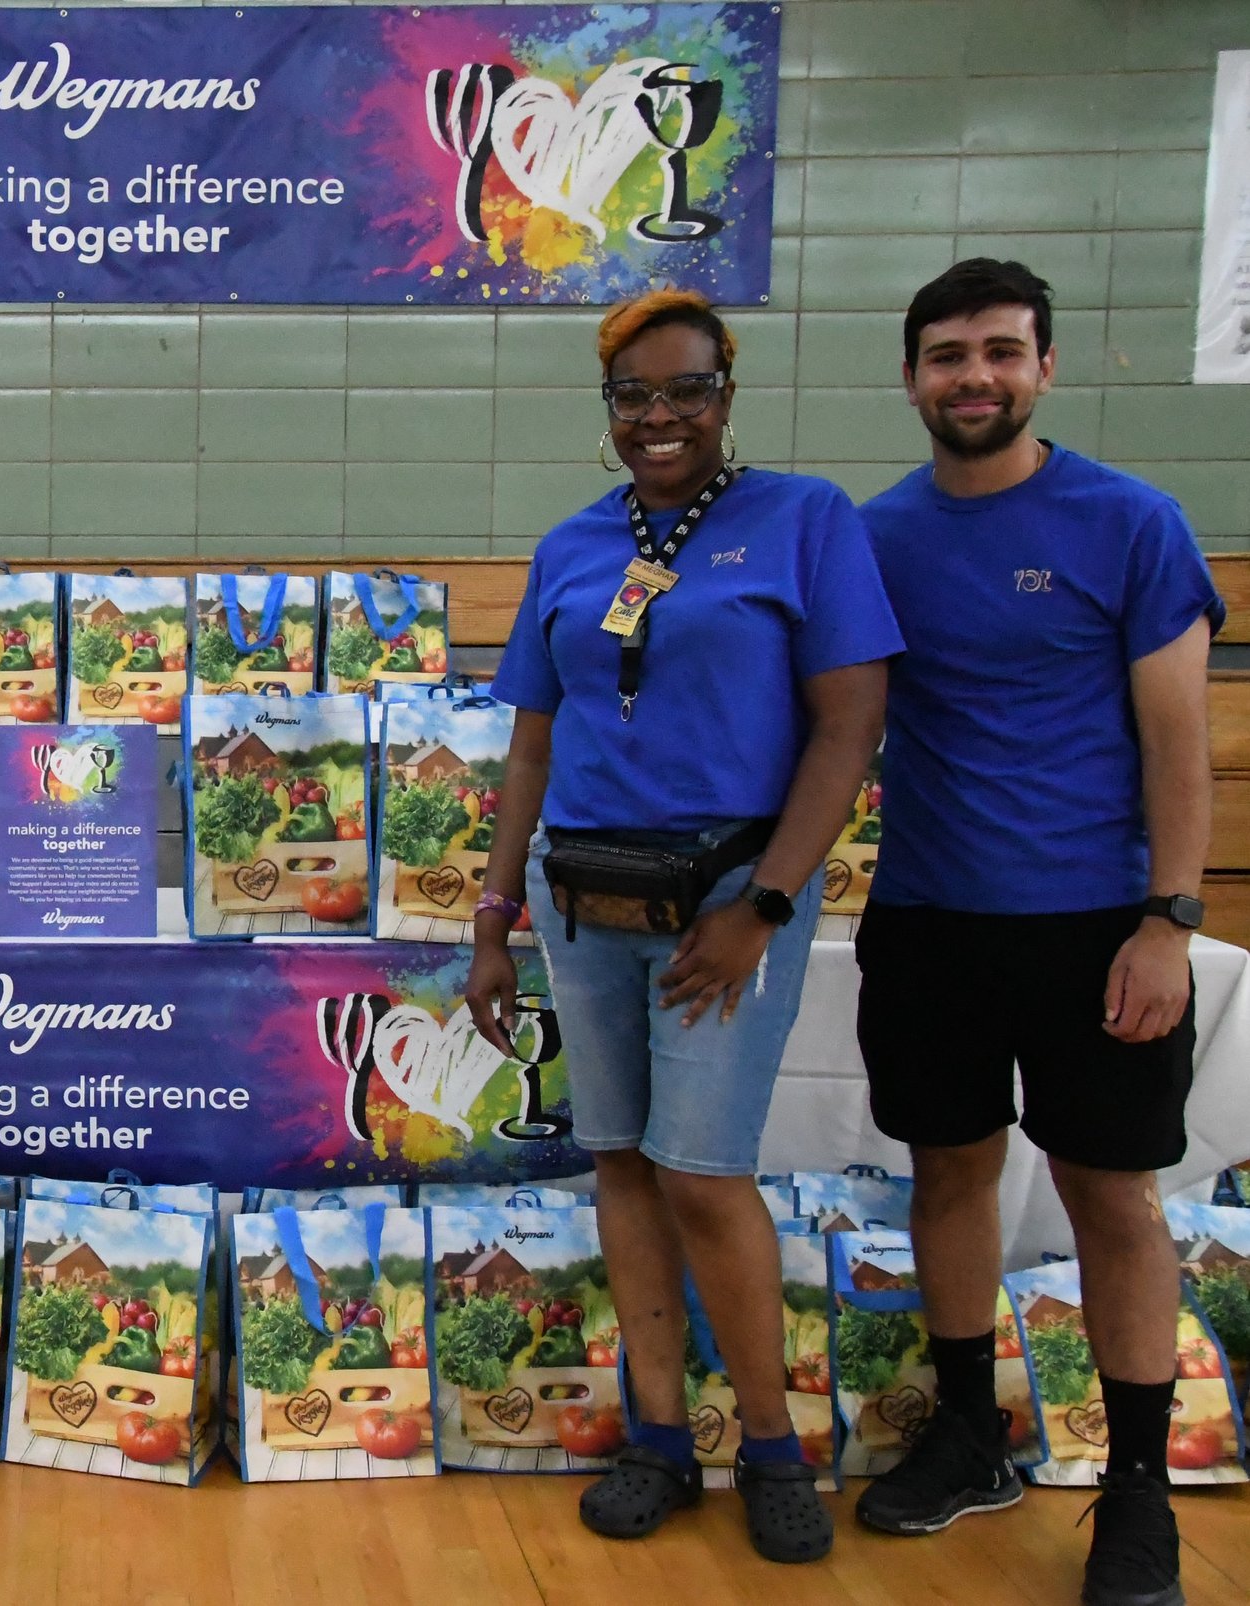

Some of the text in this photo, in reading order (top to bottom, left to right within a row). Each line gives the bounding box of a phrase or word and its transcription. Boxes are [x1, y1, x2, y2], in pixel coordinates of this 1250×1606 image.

[87, 177, 109, 203] a
[124, 163, 345, 205] difference
[28, 214, 230, 264] together
[641, 563, 674, 582] MEGHAN
[255, 711, 302, 729] Wegmans
[8, 822, 141, 838] making a difference
[43, 837, 106, 853] together
[41, 907, 105, 931] Wegmans
[30, 1085, 49, 1107] a
[63, 1075, 250, 1110] difference
[503, 1225, 555, 1245] Wegmans
